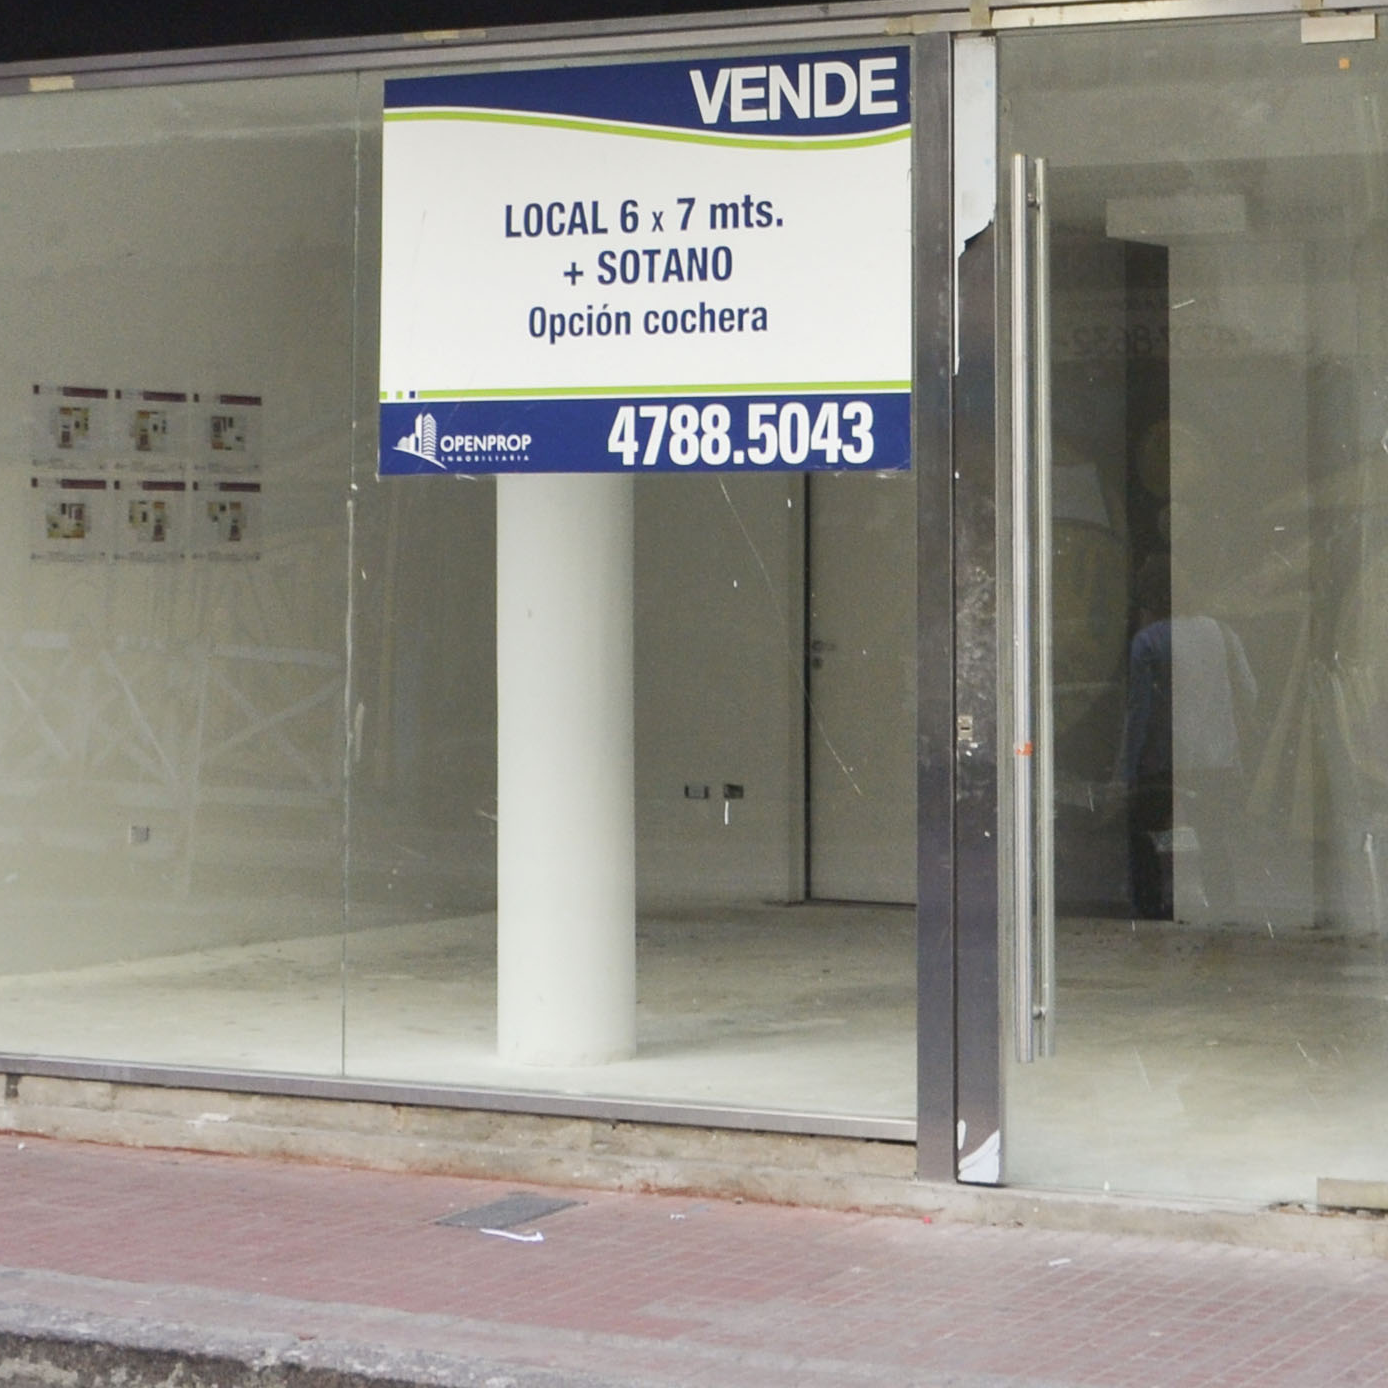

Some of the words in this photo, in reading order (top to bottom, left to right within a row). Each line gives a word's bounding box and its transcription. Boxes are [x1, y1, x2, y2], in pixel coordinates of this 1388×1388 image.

[689, 56, 898, 124] VENDE
[505, 200, 608, 239] LOCAL
[619, 198, 640, 234] 6
[652, 210, 664, 232] x
[676, 196, 697, 232] 7
[709, 193, 784, 230] mts.
[597, 245, 733, 286] SOTANO
[528, 303, 632, 346] Opción
[643, 301, 769, 336] cochera
[440, 434, 532, 452] OPENPROP
[608, 399, 875, 466] 4788.5043
